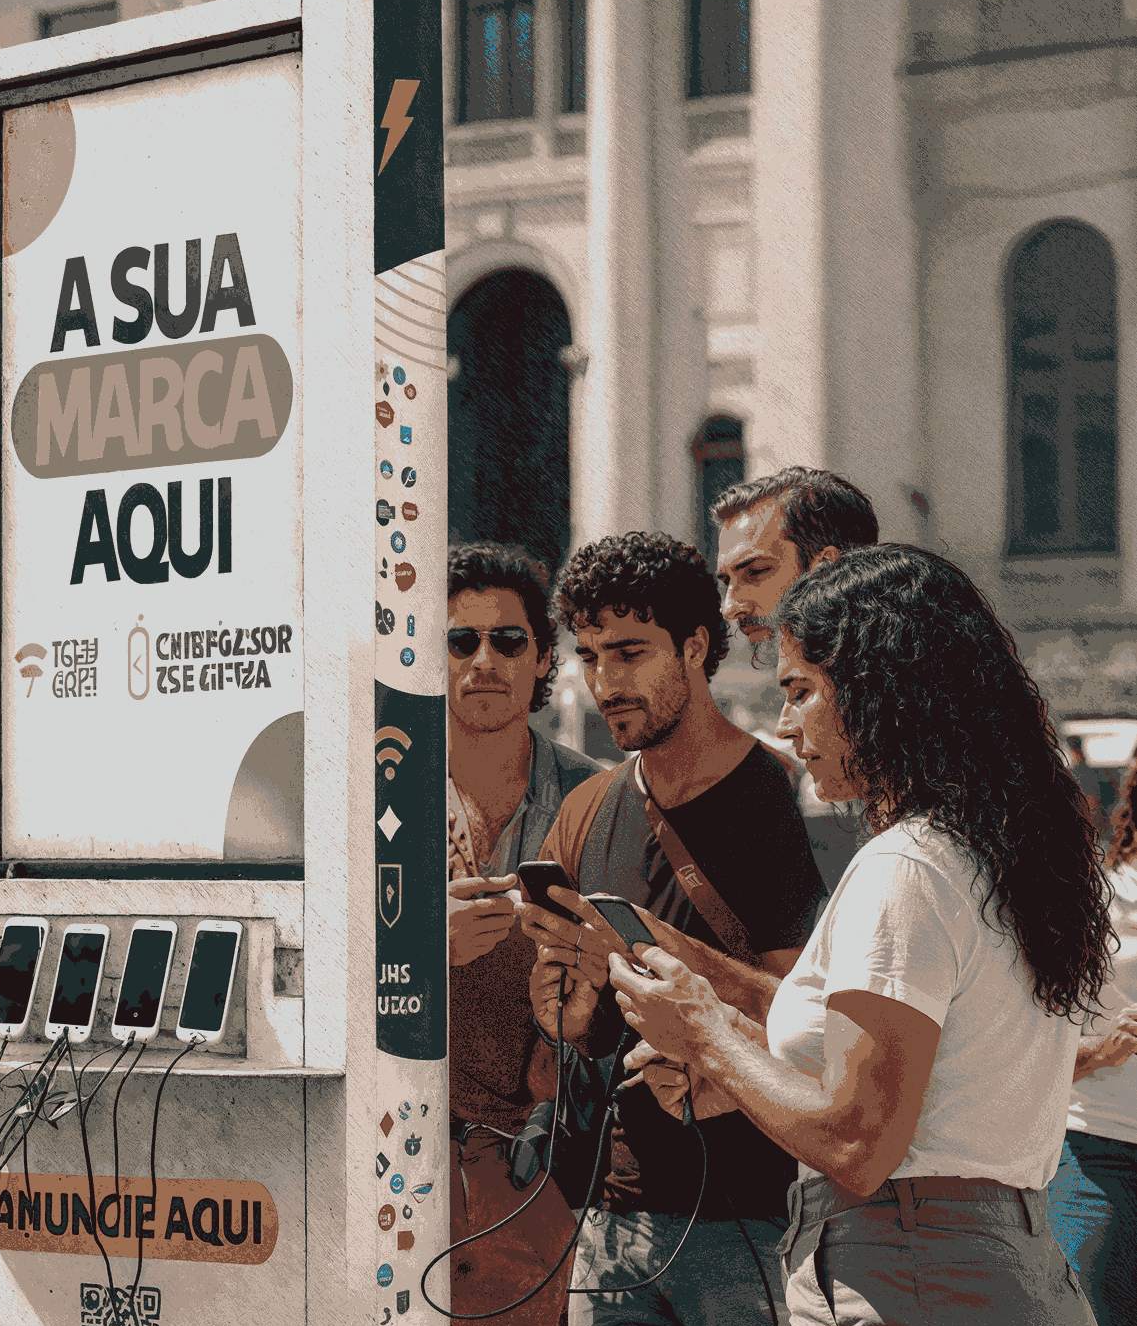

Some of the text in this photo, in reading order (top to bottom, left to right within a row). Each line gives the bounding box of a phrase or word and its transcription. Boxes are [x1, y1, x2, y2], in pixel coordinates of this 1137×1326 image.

[49, 232, 257, 353] A SUA
[35, 344, 277, 467] MARCA
[70, 477, 232, 586] AQUI
[165, 1196, 262, 1247] AQUI
